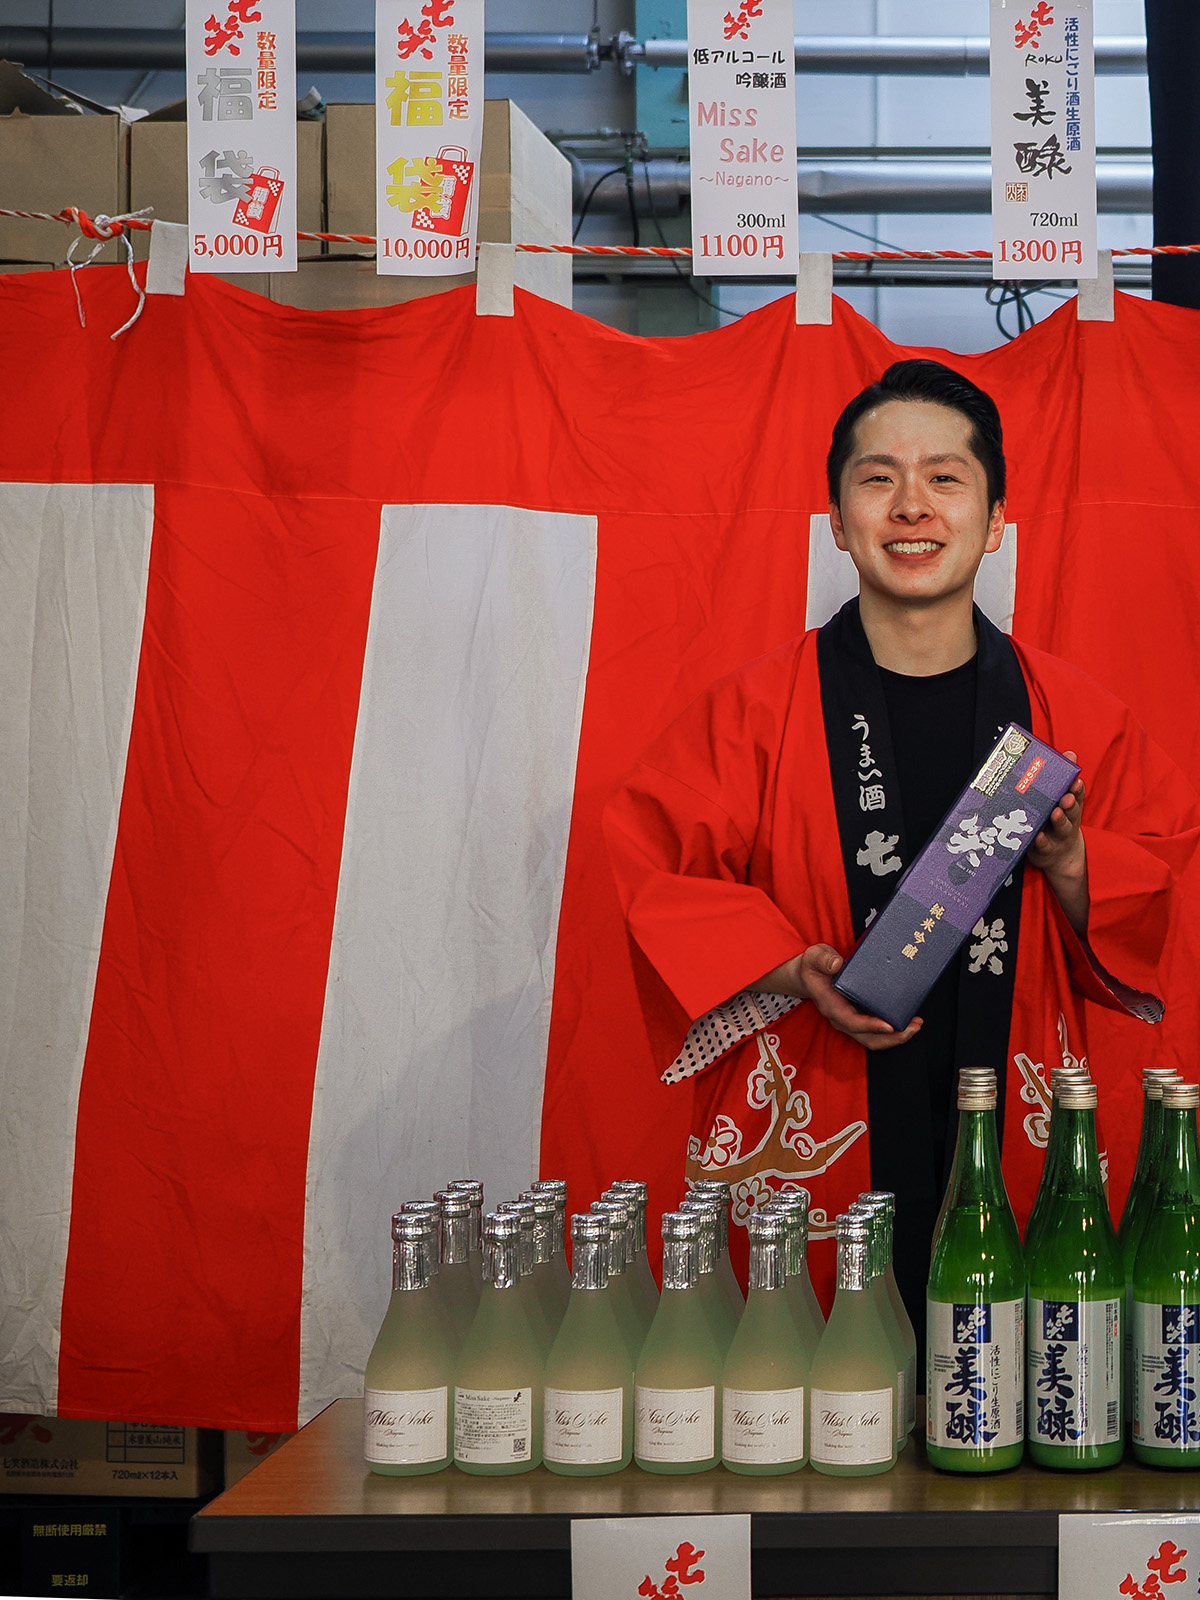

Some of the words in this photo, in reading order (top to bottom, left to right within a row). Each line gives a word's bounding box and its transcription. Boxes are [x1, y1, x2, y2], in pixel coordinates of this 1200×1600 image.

[1014, 1, 1055, 50] 七笑
[692, 47, 787, 66] 低アルコール
[256, 31, 278, 111] 数量限定
[446, 33, 470, 121] 数量限定
[735, 72, 788, 90] 吟醸酒
[1064, 17, 1082, 152] 活性にごり酒生原酒
[696, 101, 759, 128] Miss
[197, 67, 255, 205] 福袋
[385, 70, 444, 214] 福袋
[718, 136, 786, 164] Sake
[736, 213, 787, 229] 300ml
[1030, 212, 1079, 228] 720ml
[193, 233, 284, 259] 5,000円
[381, 236, 471, 261] 10,000円
[700, 234, 785, 260] 1100円
[998, 239, 1083, 265] 1300円
[946, 808, 1034, 868] 七笑
[32, 1523, 108, 1537] 無断使用厳禁
